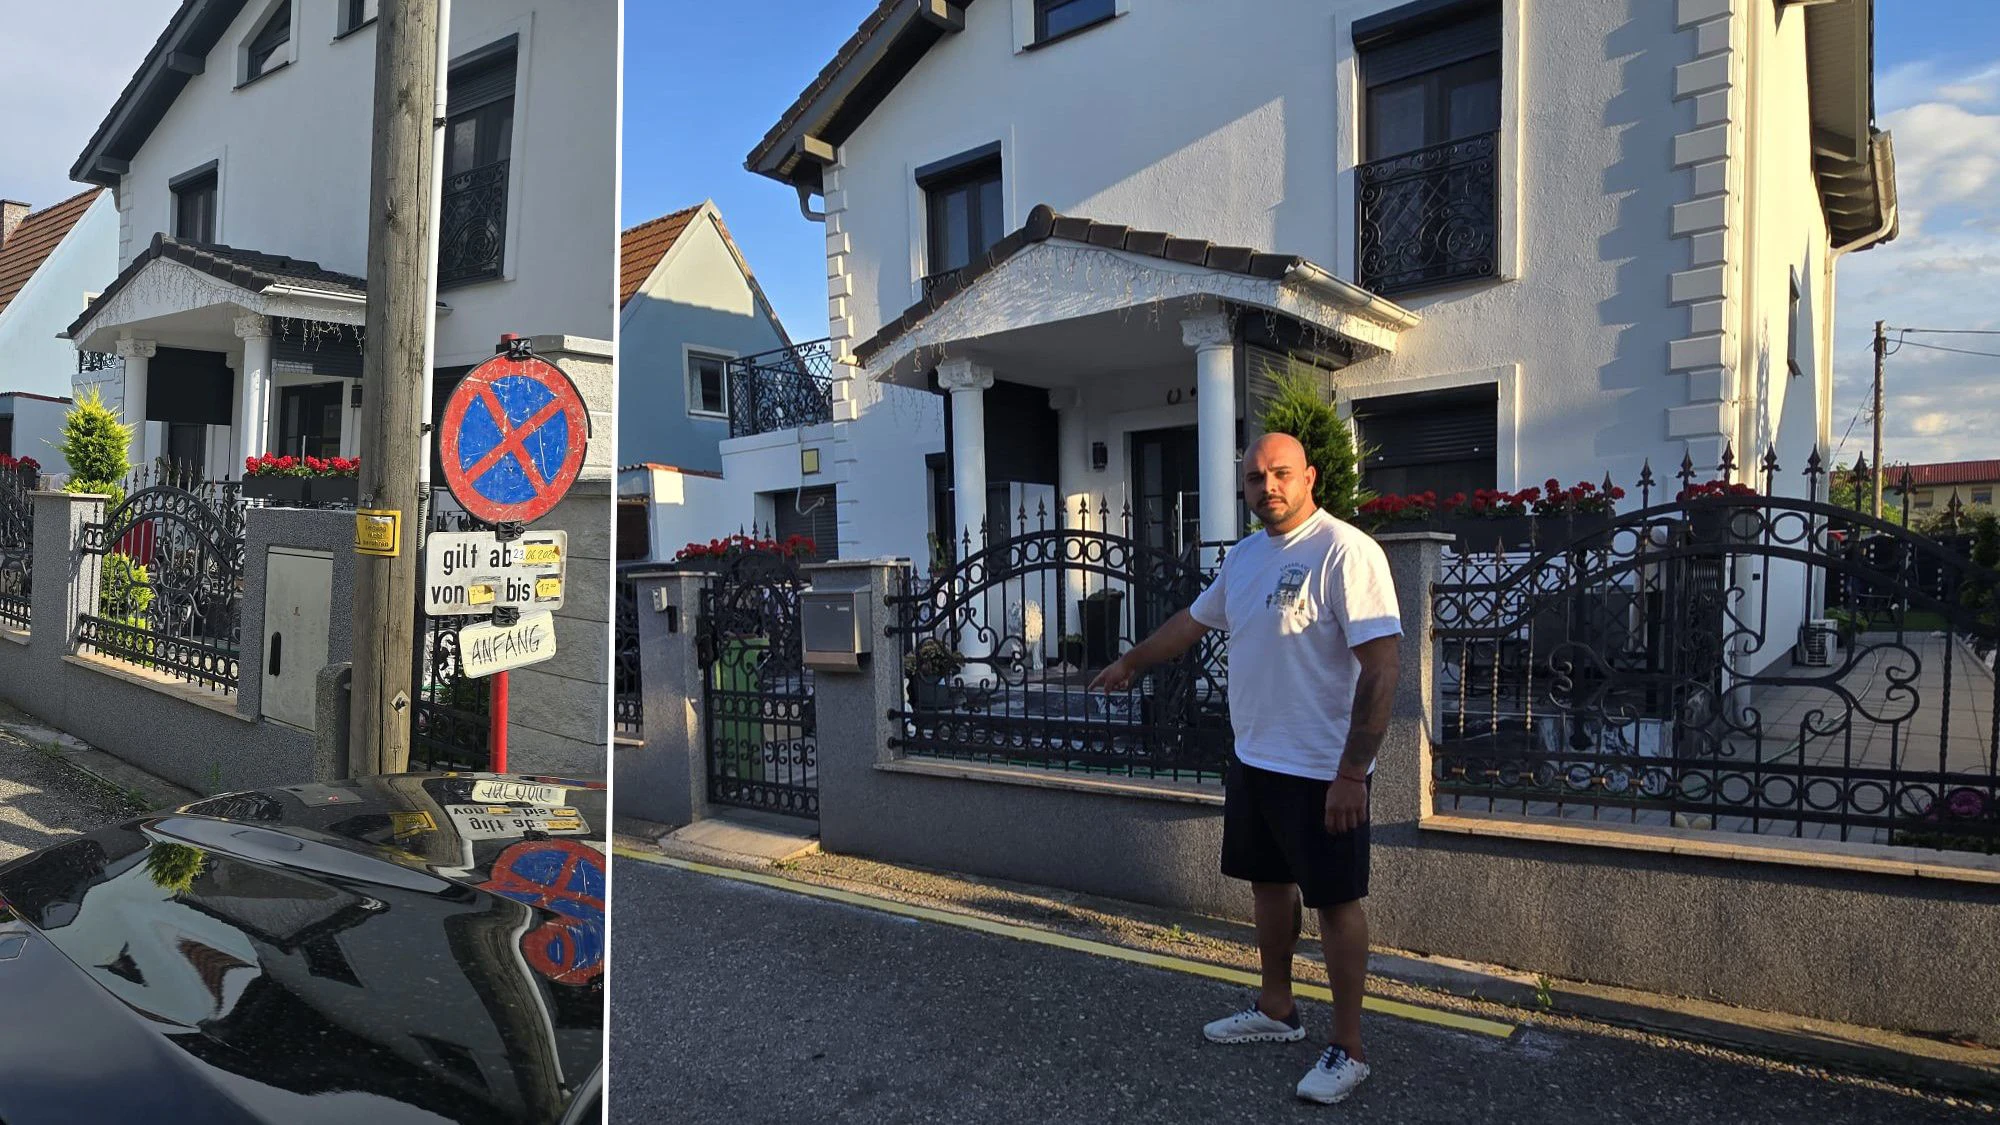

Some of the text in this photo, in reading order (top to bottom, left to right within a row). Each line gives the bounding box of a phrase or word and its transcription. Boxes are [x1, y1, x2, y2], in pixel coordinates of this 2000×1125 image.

[443, 543, 478, 575] gilt
[489, 542, 512, 568] ab
[431, 585, 464, 604] von
[506, 577, 531, 602] bis
[471, 624, 540, 666] ANFANG
